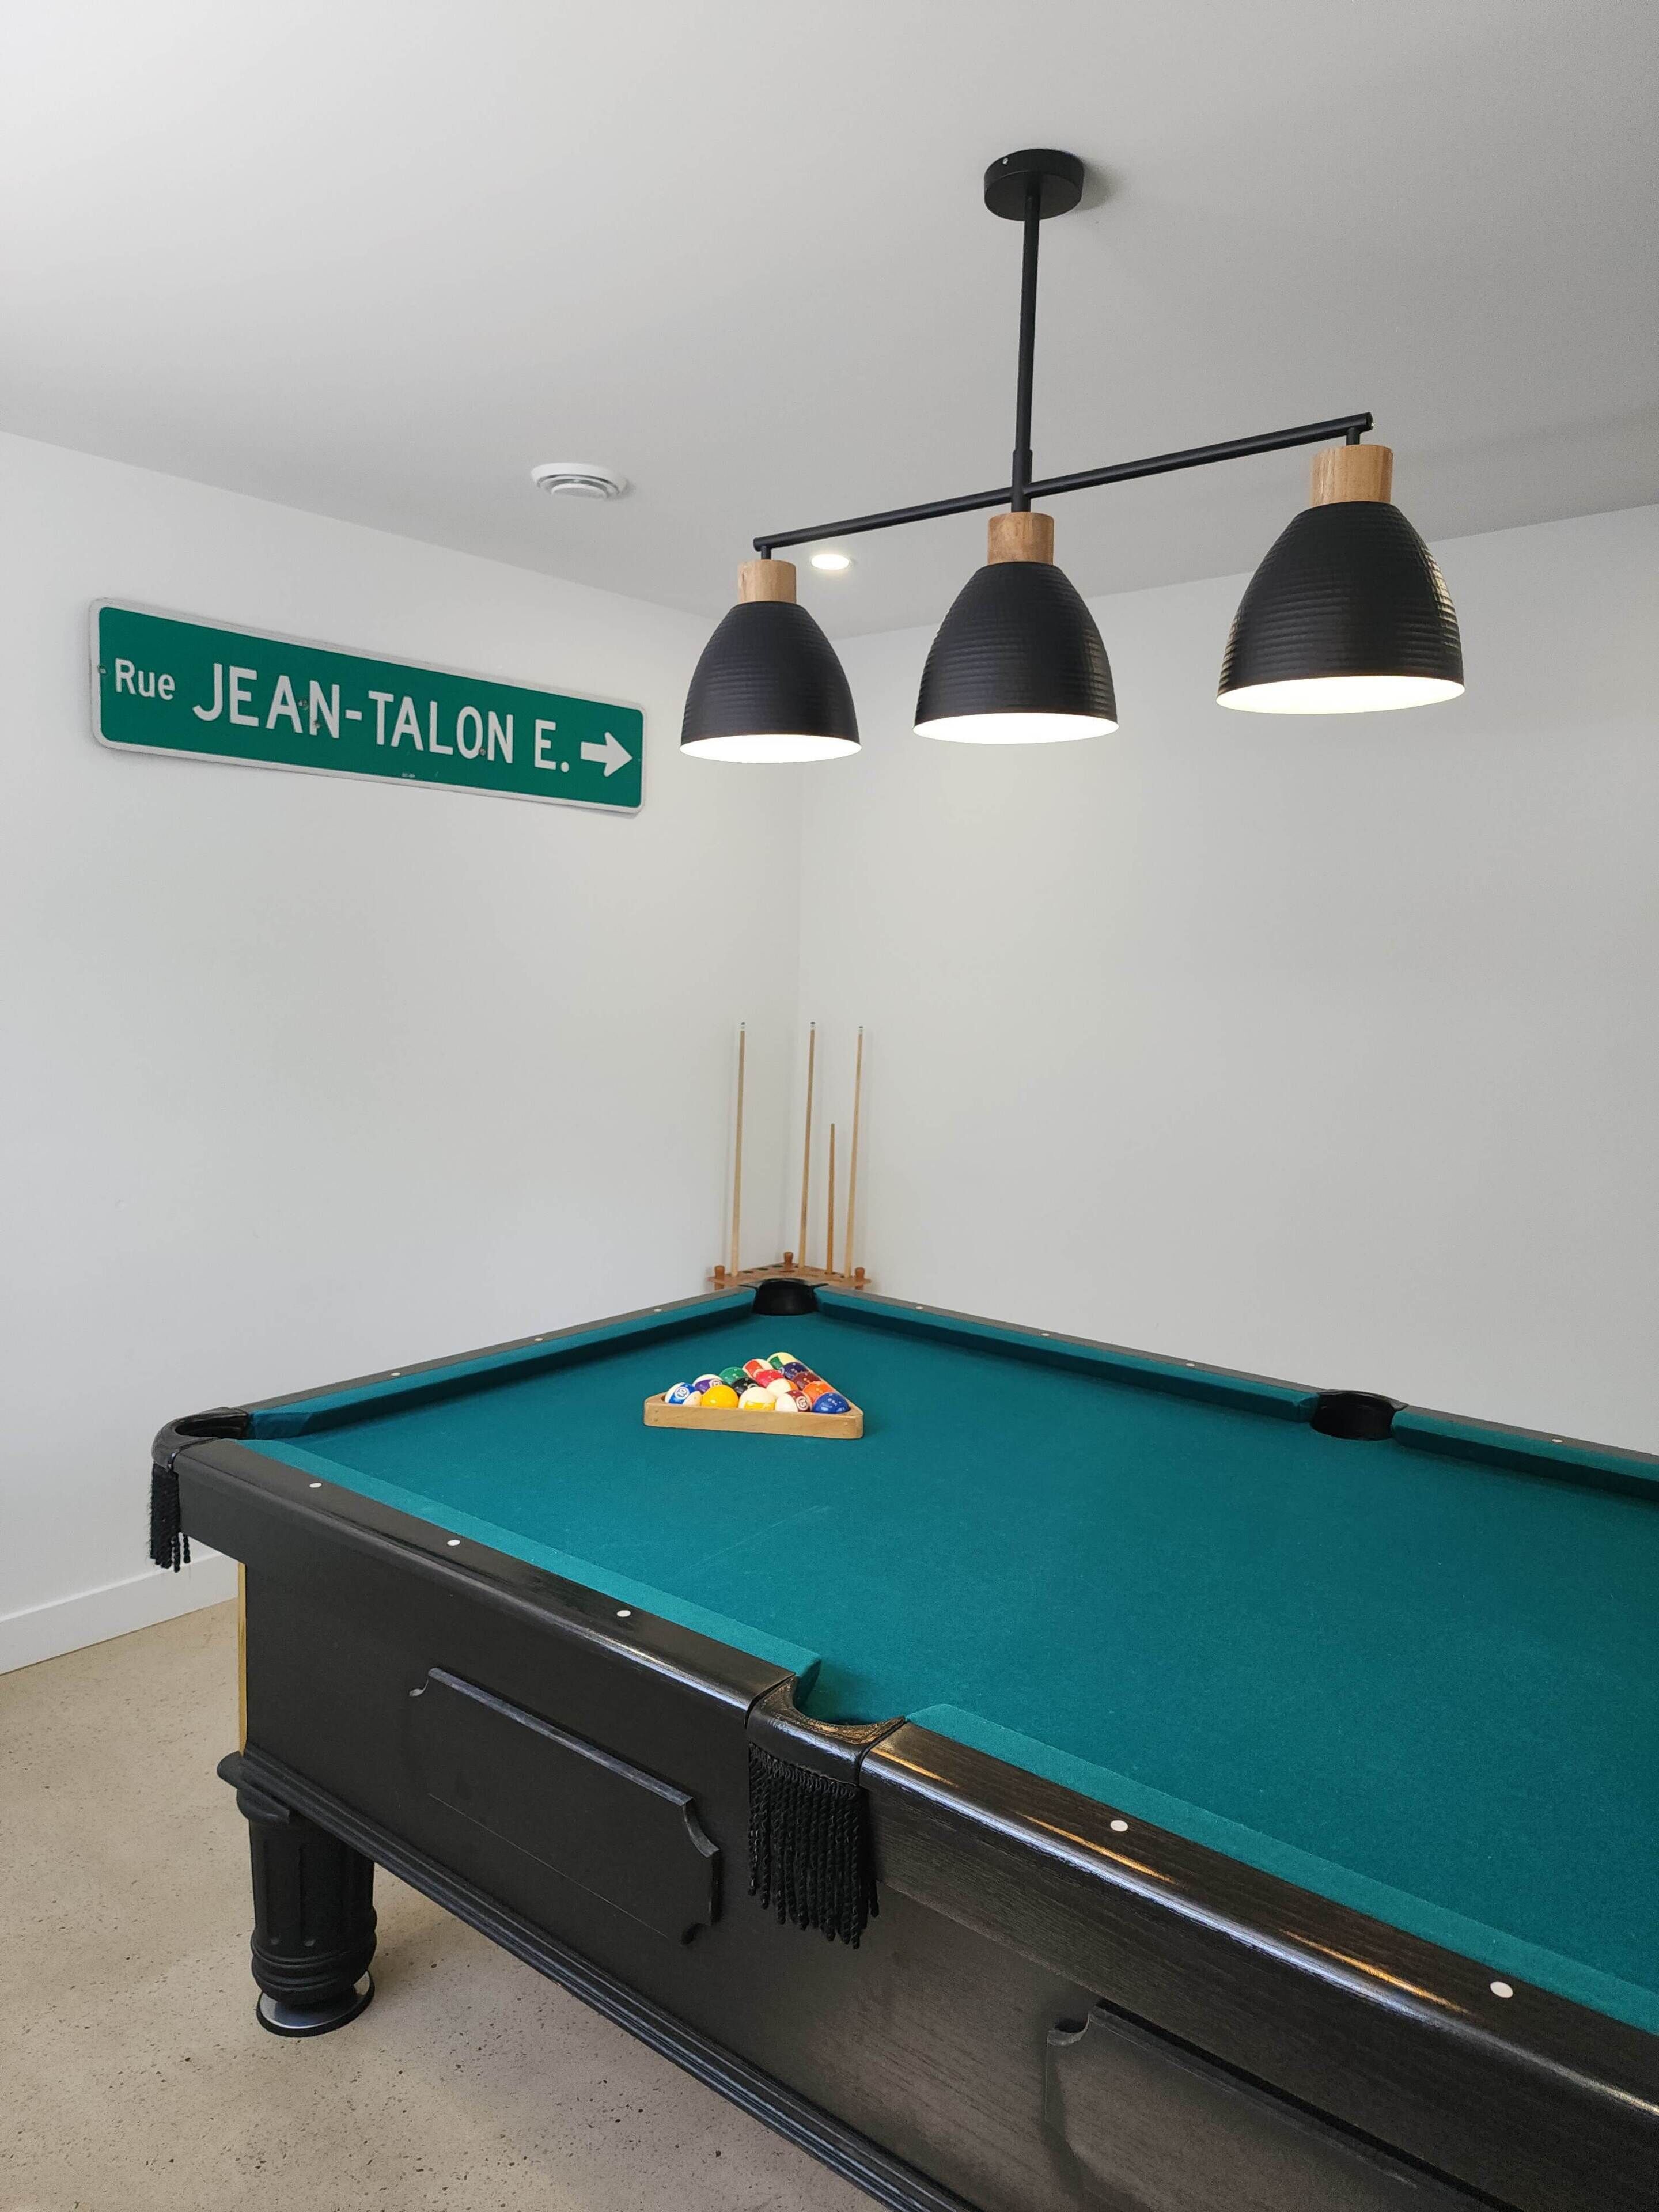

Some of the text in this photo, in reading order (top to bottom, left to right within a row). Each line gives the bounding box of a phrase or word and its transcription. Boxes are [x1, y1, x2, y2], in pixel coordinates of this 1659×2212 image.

[115, 658, 569, 772] Rue JEAN-TALON E.
